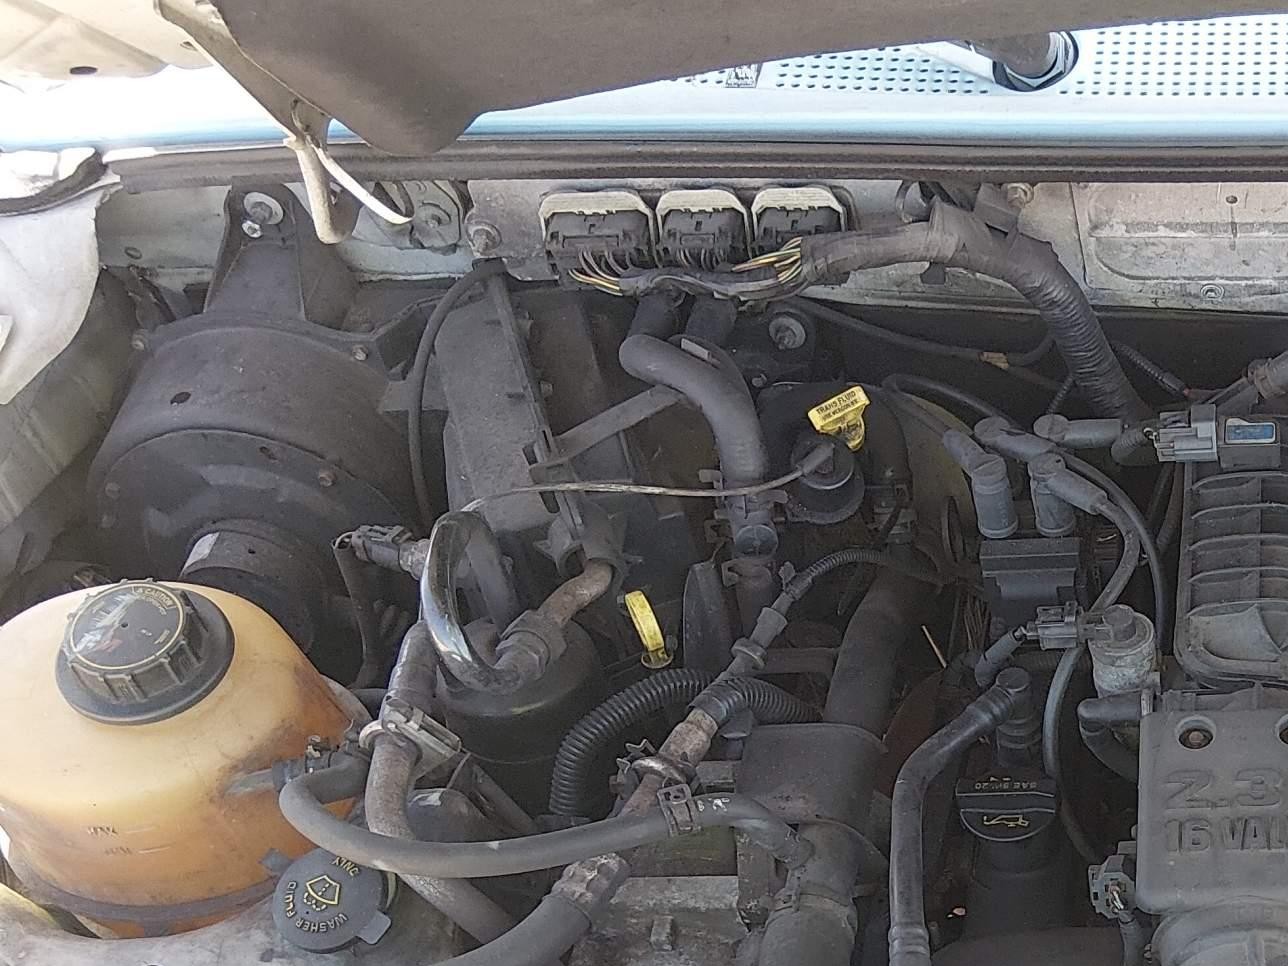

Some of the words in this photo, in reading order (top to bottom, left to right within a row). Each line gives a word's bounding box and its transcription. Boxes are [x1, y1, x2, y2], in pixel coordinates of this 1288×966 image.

[816, 401, 838, 414] TRANS
[838, 390, 856, 406] FLUID
[1165, 818, 1212, 852] 16
[331, 855, 361, 877] ONLY
[284, 880, 298, 918] FLUID
[295, 913, 349, 934] WASHER
